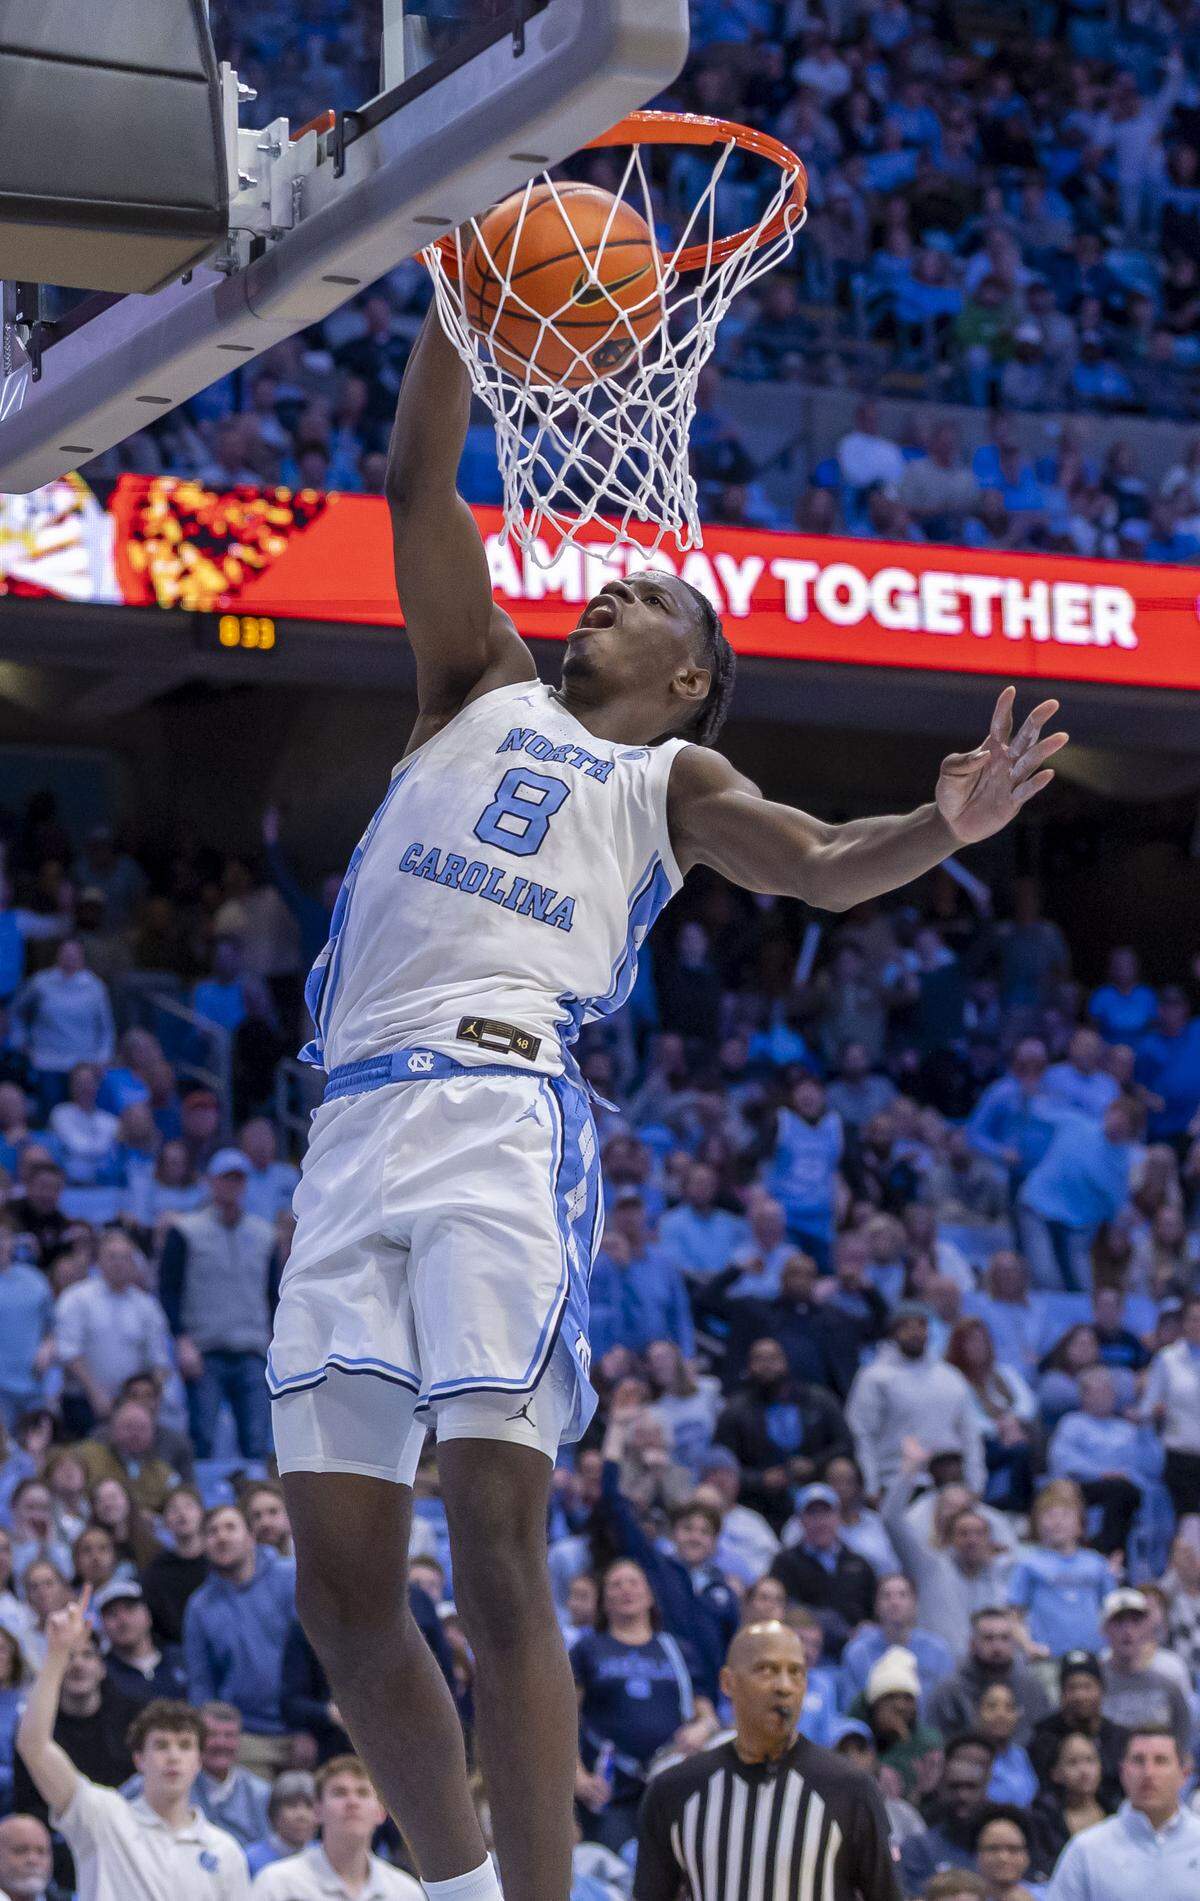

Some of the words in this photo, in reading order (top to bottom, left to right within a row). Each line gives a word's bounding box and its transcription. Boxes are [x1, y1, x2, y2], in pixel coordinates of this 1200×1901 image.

[770, 557, 1139, 650] TOGETHER
[495, 727, 615, 784] NORTH
[473, 767, 571, 857] 8
[399, 842, 576, 932] CAROLINA
[516, 1037, 529, 1050] 48
